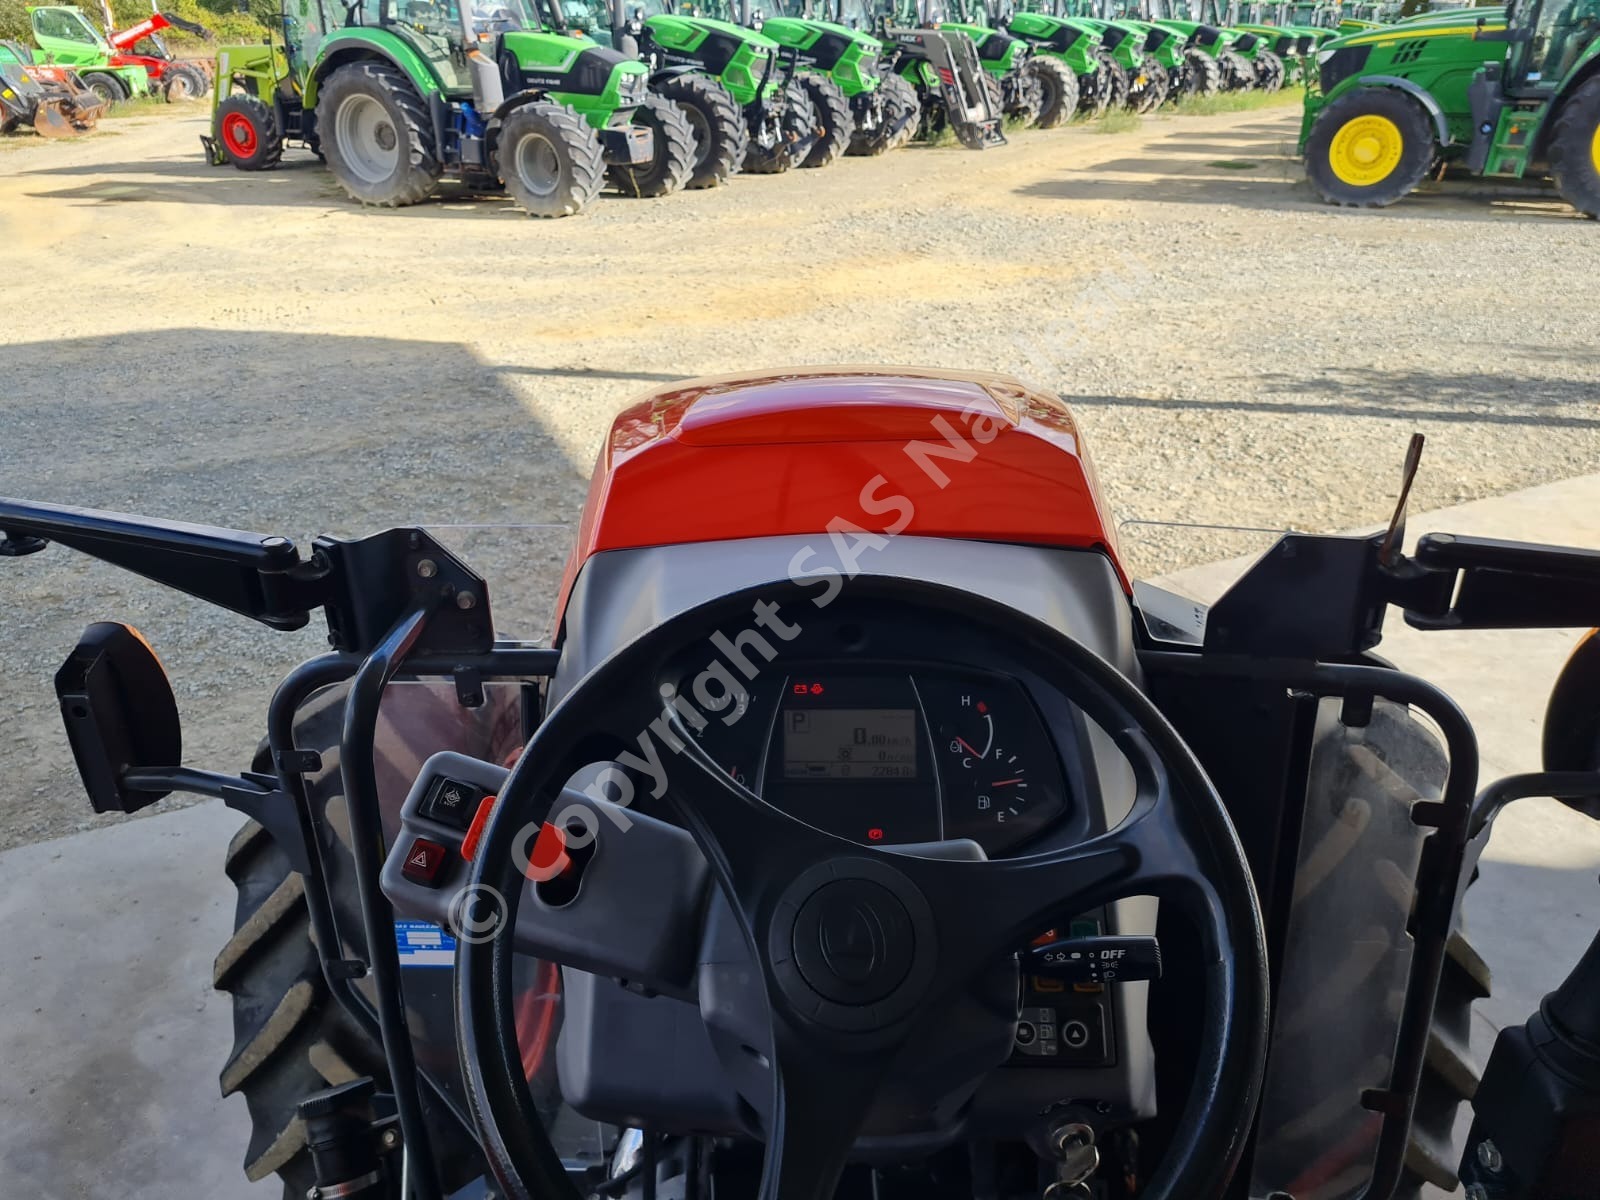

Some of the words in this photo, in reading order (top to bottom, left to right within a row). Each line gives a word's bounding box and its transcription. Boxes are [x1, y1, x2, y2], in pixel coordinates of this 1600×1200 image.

[961, 695, 971, 706] H
[792, 712, 805, 732] P
[995, 748, 1003, 759] F
[962, 757, 972, 769] C
[997, 811, 1005, 822] E
[1100, 949, 1126, 960] OFF
